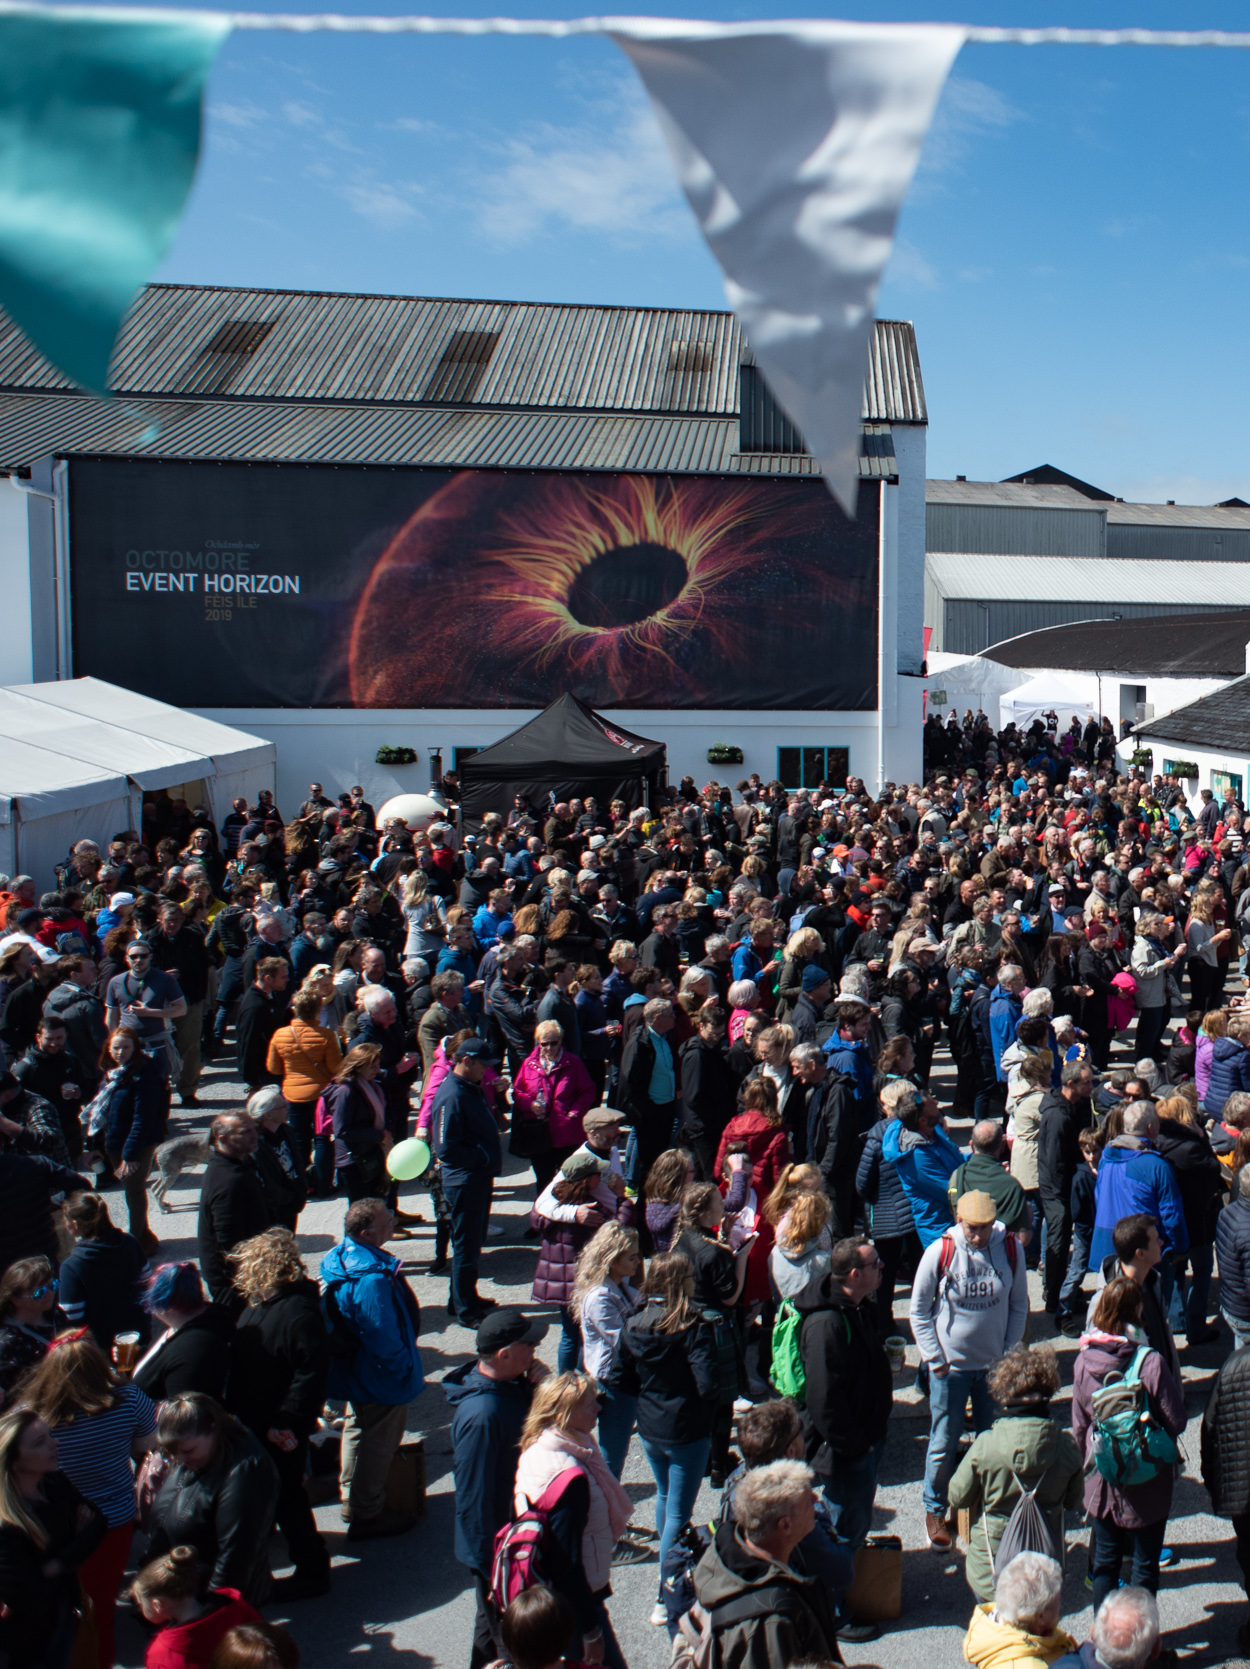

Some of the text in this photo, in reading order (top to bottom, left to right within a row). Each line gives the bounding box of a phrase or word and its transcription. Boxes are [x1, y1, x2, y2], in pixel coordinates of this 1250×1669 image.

[126, 550, 250, 571] OCTOMORE
[126, 572, 300, 594] EVENT HORIZON
[205, 594, 233, 608] FÈIS
[205, 609, 232, 621] 2019
[964, 1280, 994, 1298] 1991
[956, 1297, 1000, 1310] SWITZERLAND
